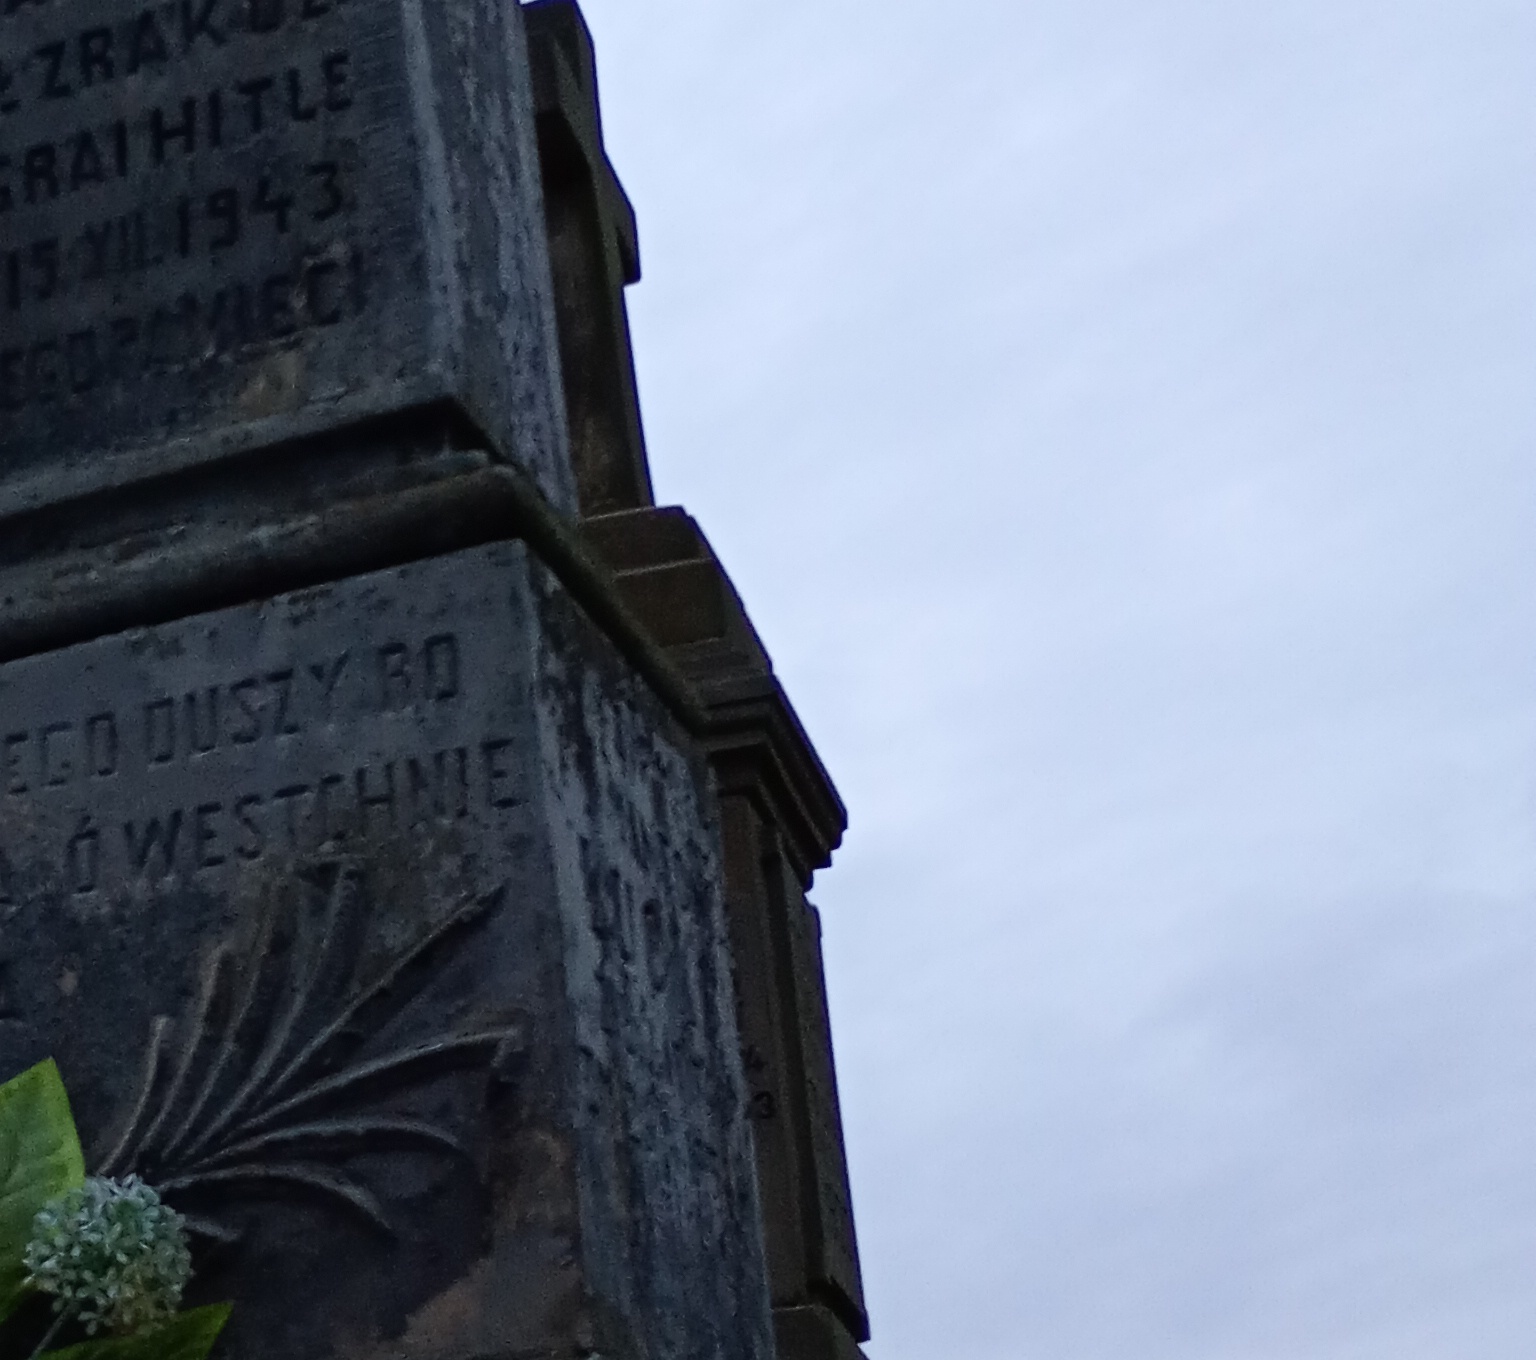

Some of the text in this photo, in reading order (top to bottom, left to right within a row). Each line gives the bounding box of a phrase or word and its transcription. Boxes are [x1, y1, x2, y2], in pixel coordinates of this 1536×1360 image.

[151, 50, 354, 167] HITLE
[143, 649, 352, 764] DUSZY
[123, 737, 522, 879] WESTCHNIE
